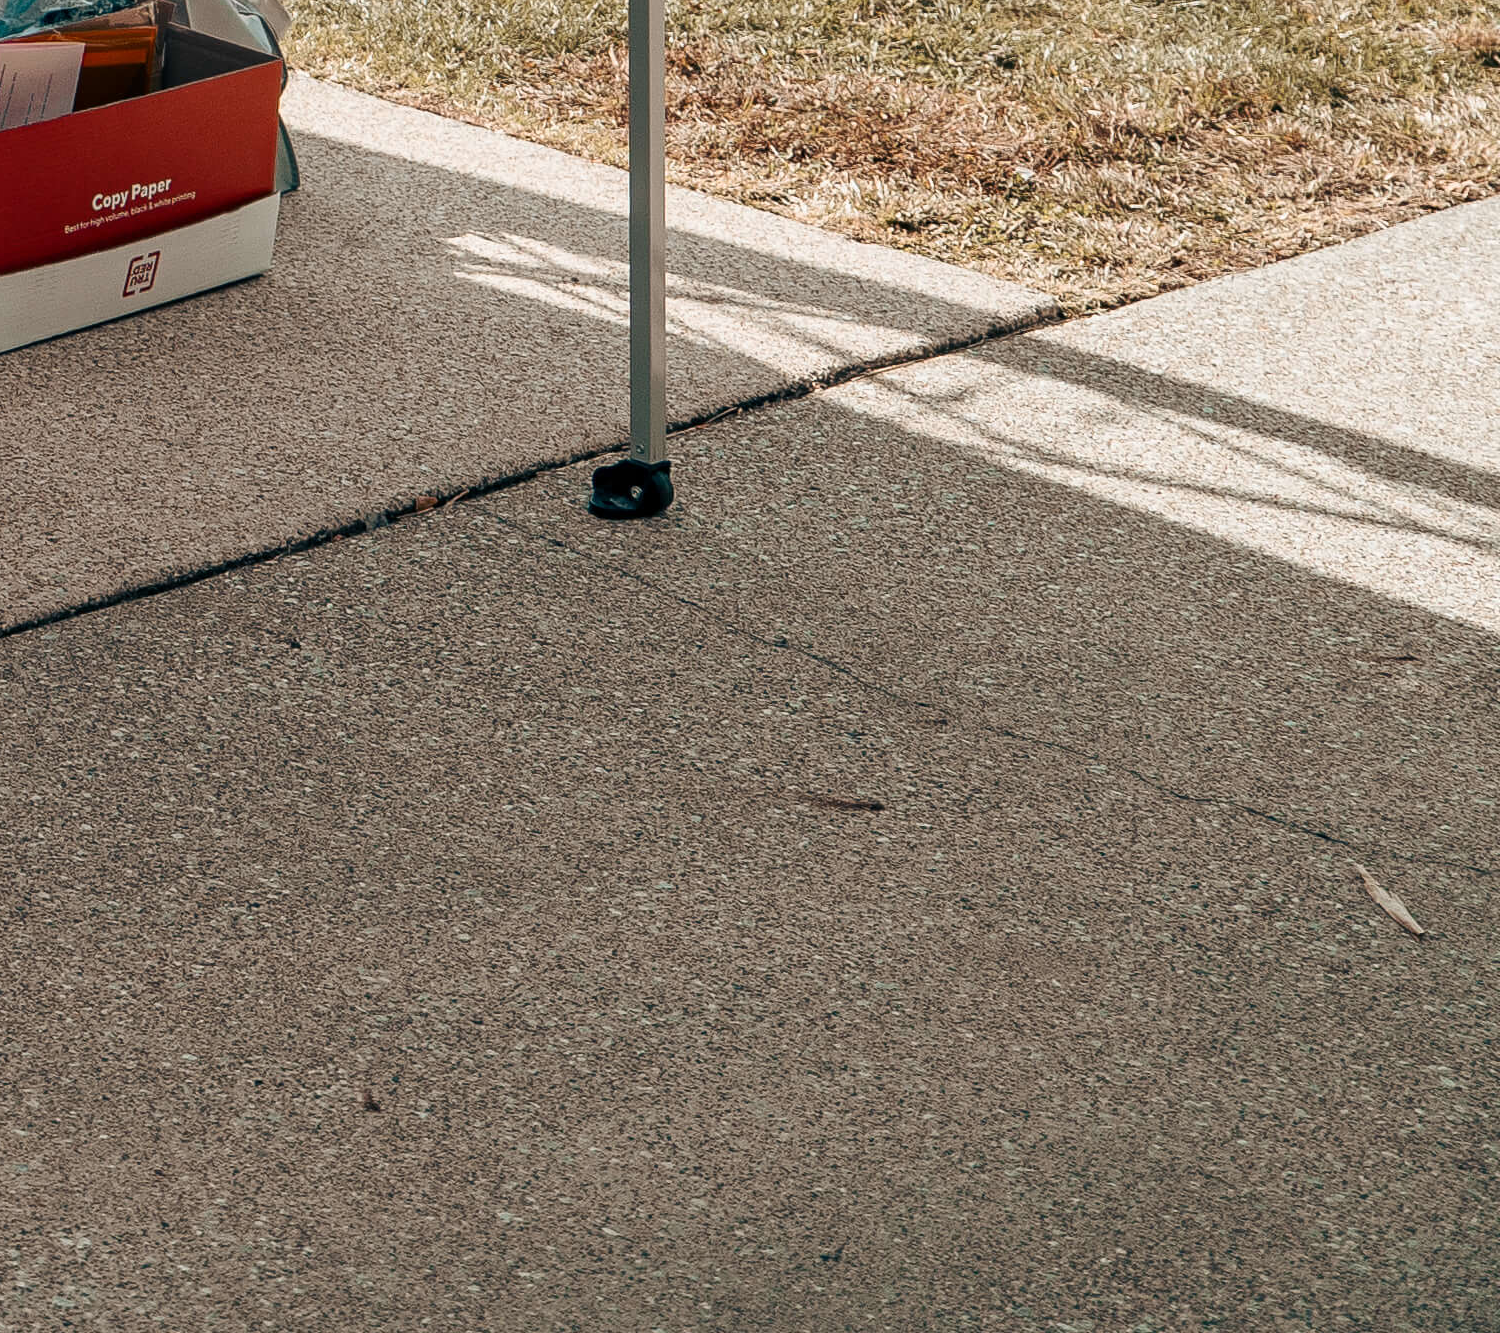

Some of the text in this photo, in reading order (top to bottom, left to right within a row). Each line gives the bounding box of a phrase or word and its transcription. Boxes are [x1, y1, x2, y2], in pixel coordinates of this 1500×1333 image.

[92, 178, 172, 211] Copy Paper
[64, 223, 80, 234] Best
[80, 221, 91, 230] for
[90, 217, 105, 227] high
[130, 205, 148, 215] black
[154, 198, 172, 208] white
[171, 191, 197, 205] printing
[132, 261, 154, 275] RED
[130, 273, 149, 287] TRU
